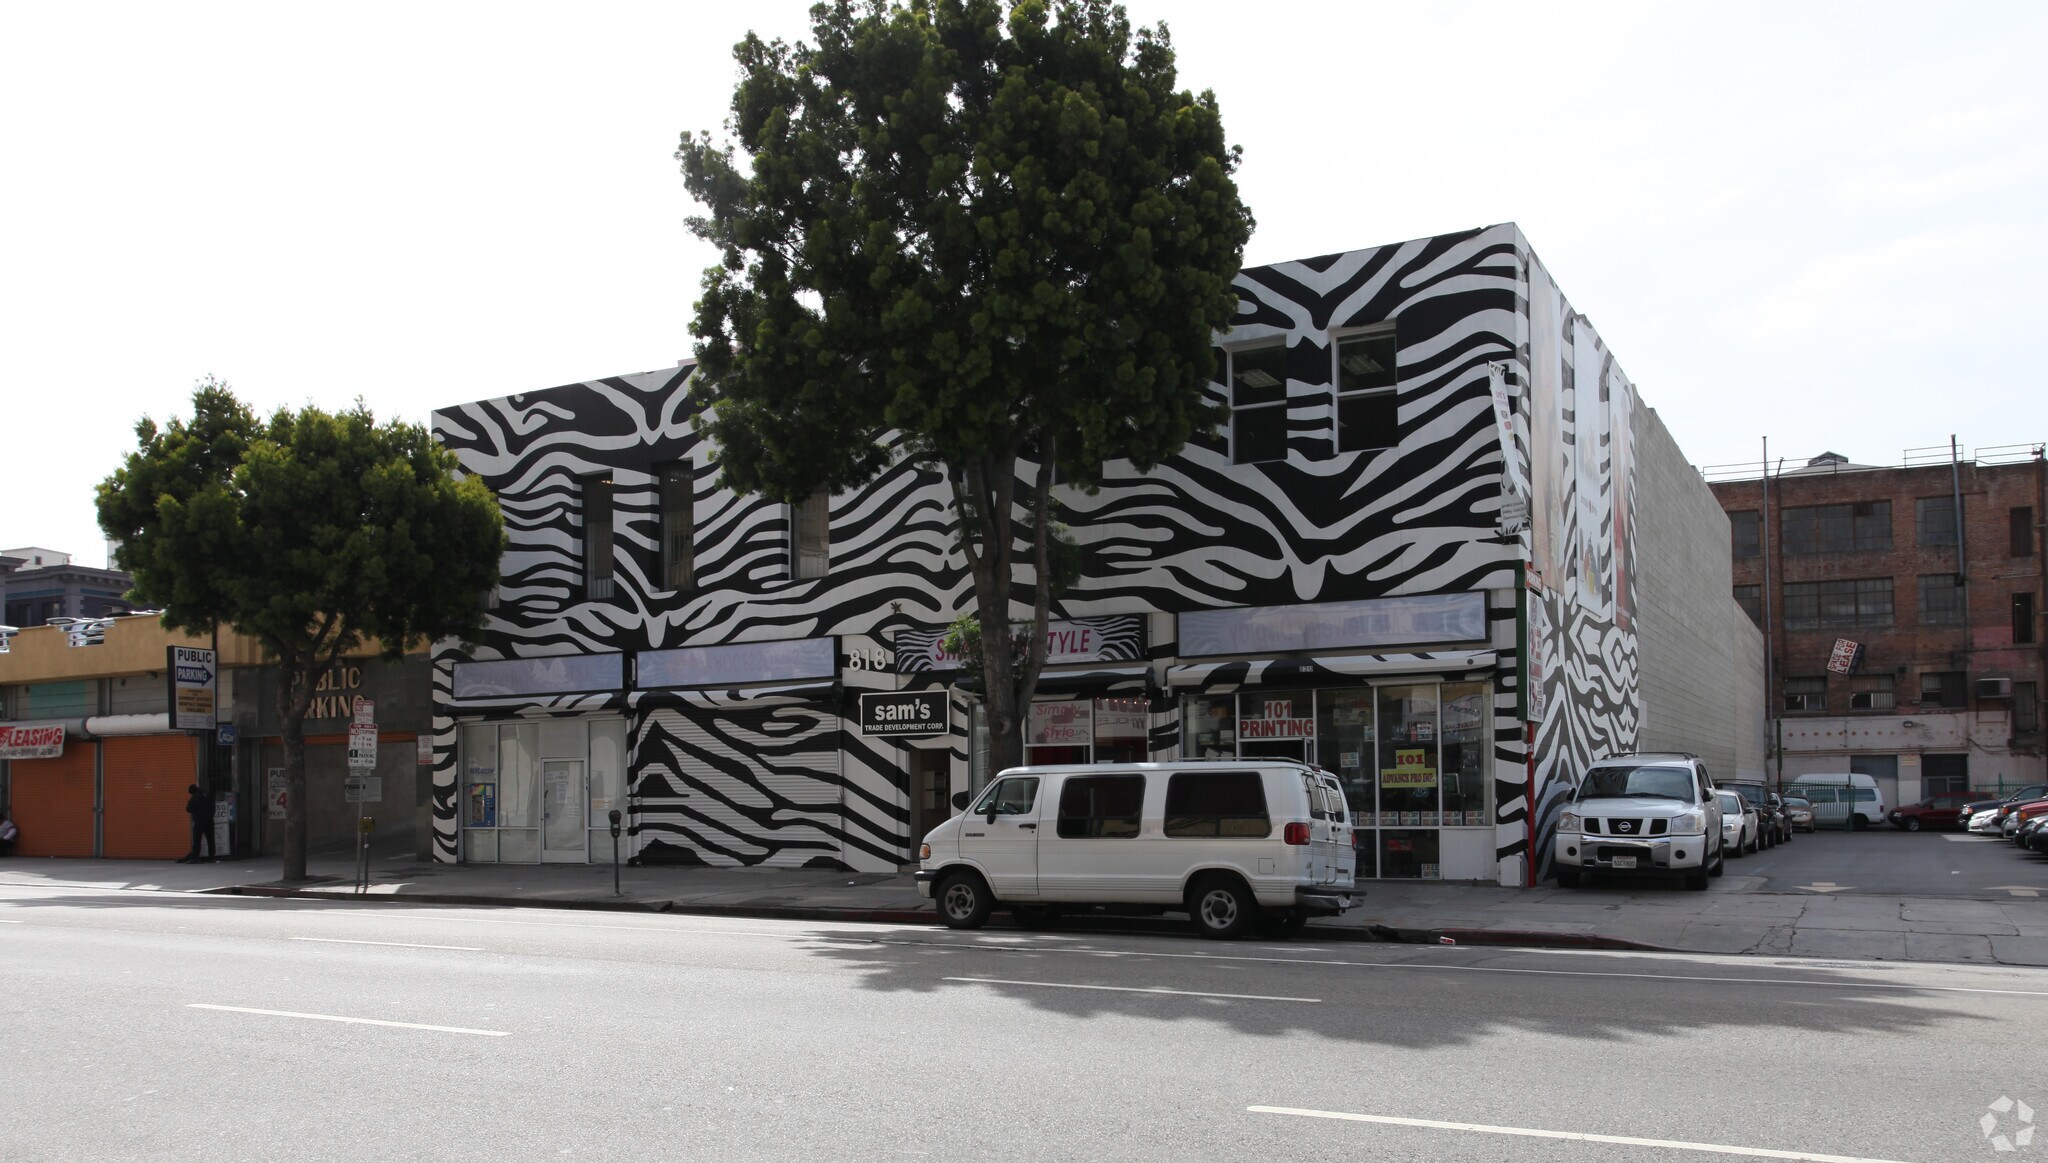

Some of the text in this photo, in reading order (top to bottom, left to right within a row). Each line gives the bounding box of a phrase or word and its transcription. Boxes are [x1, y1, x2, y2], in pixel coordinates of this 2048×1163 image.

[1047, 629, 1092, 659] TYLE
[1836, 640, 1846, 652] FOR
[177, 649, 212, 663] PUBLIC
[850, 648, 886, 671] 818
[1837, 642, 1856, 673] LEASE
[177, 668, 208, 681] PARKING
[875, 699, 931, 721] sam's
[1265, 702, 1291, 718] 101
[865, 724, 884, 732] TRADE
[884, 723, 927, 731] DEVELOPMENT
[1240, 719, 1314, 737] PRINTING
[8, 727, 63, 748] LEASING
[1397, 754, 1424, 765] 101
[1383, 774, 1409, 784] ADVANCE
[1410, 773, 1422, 783] PRO
